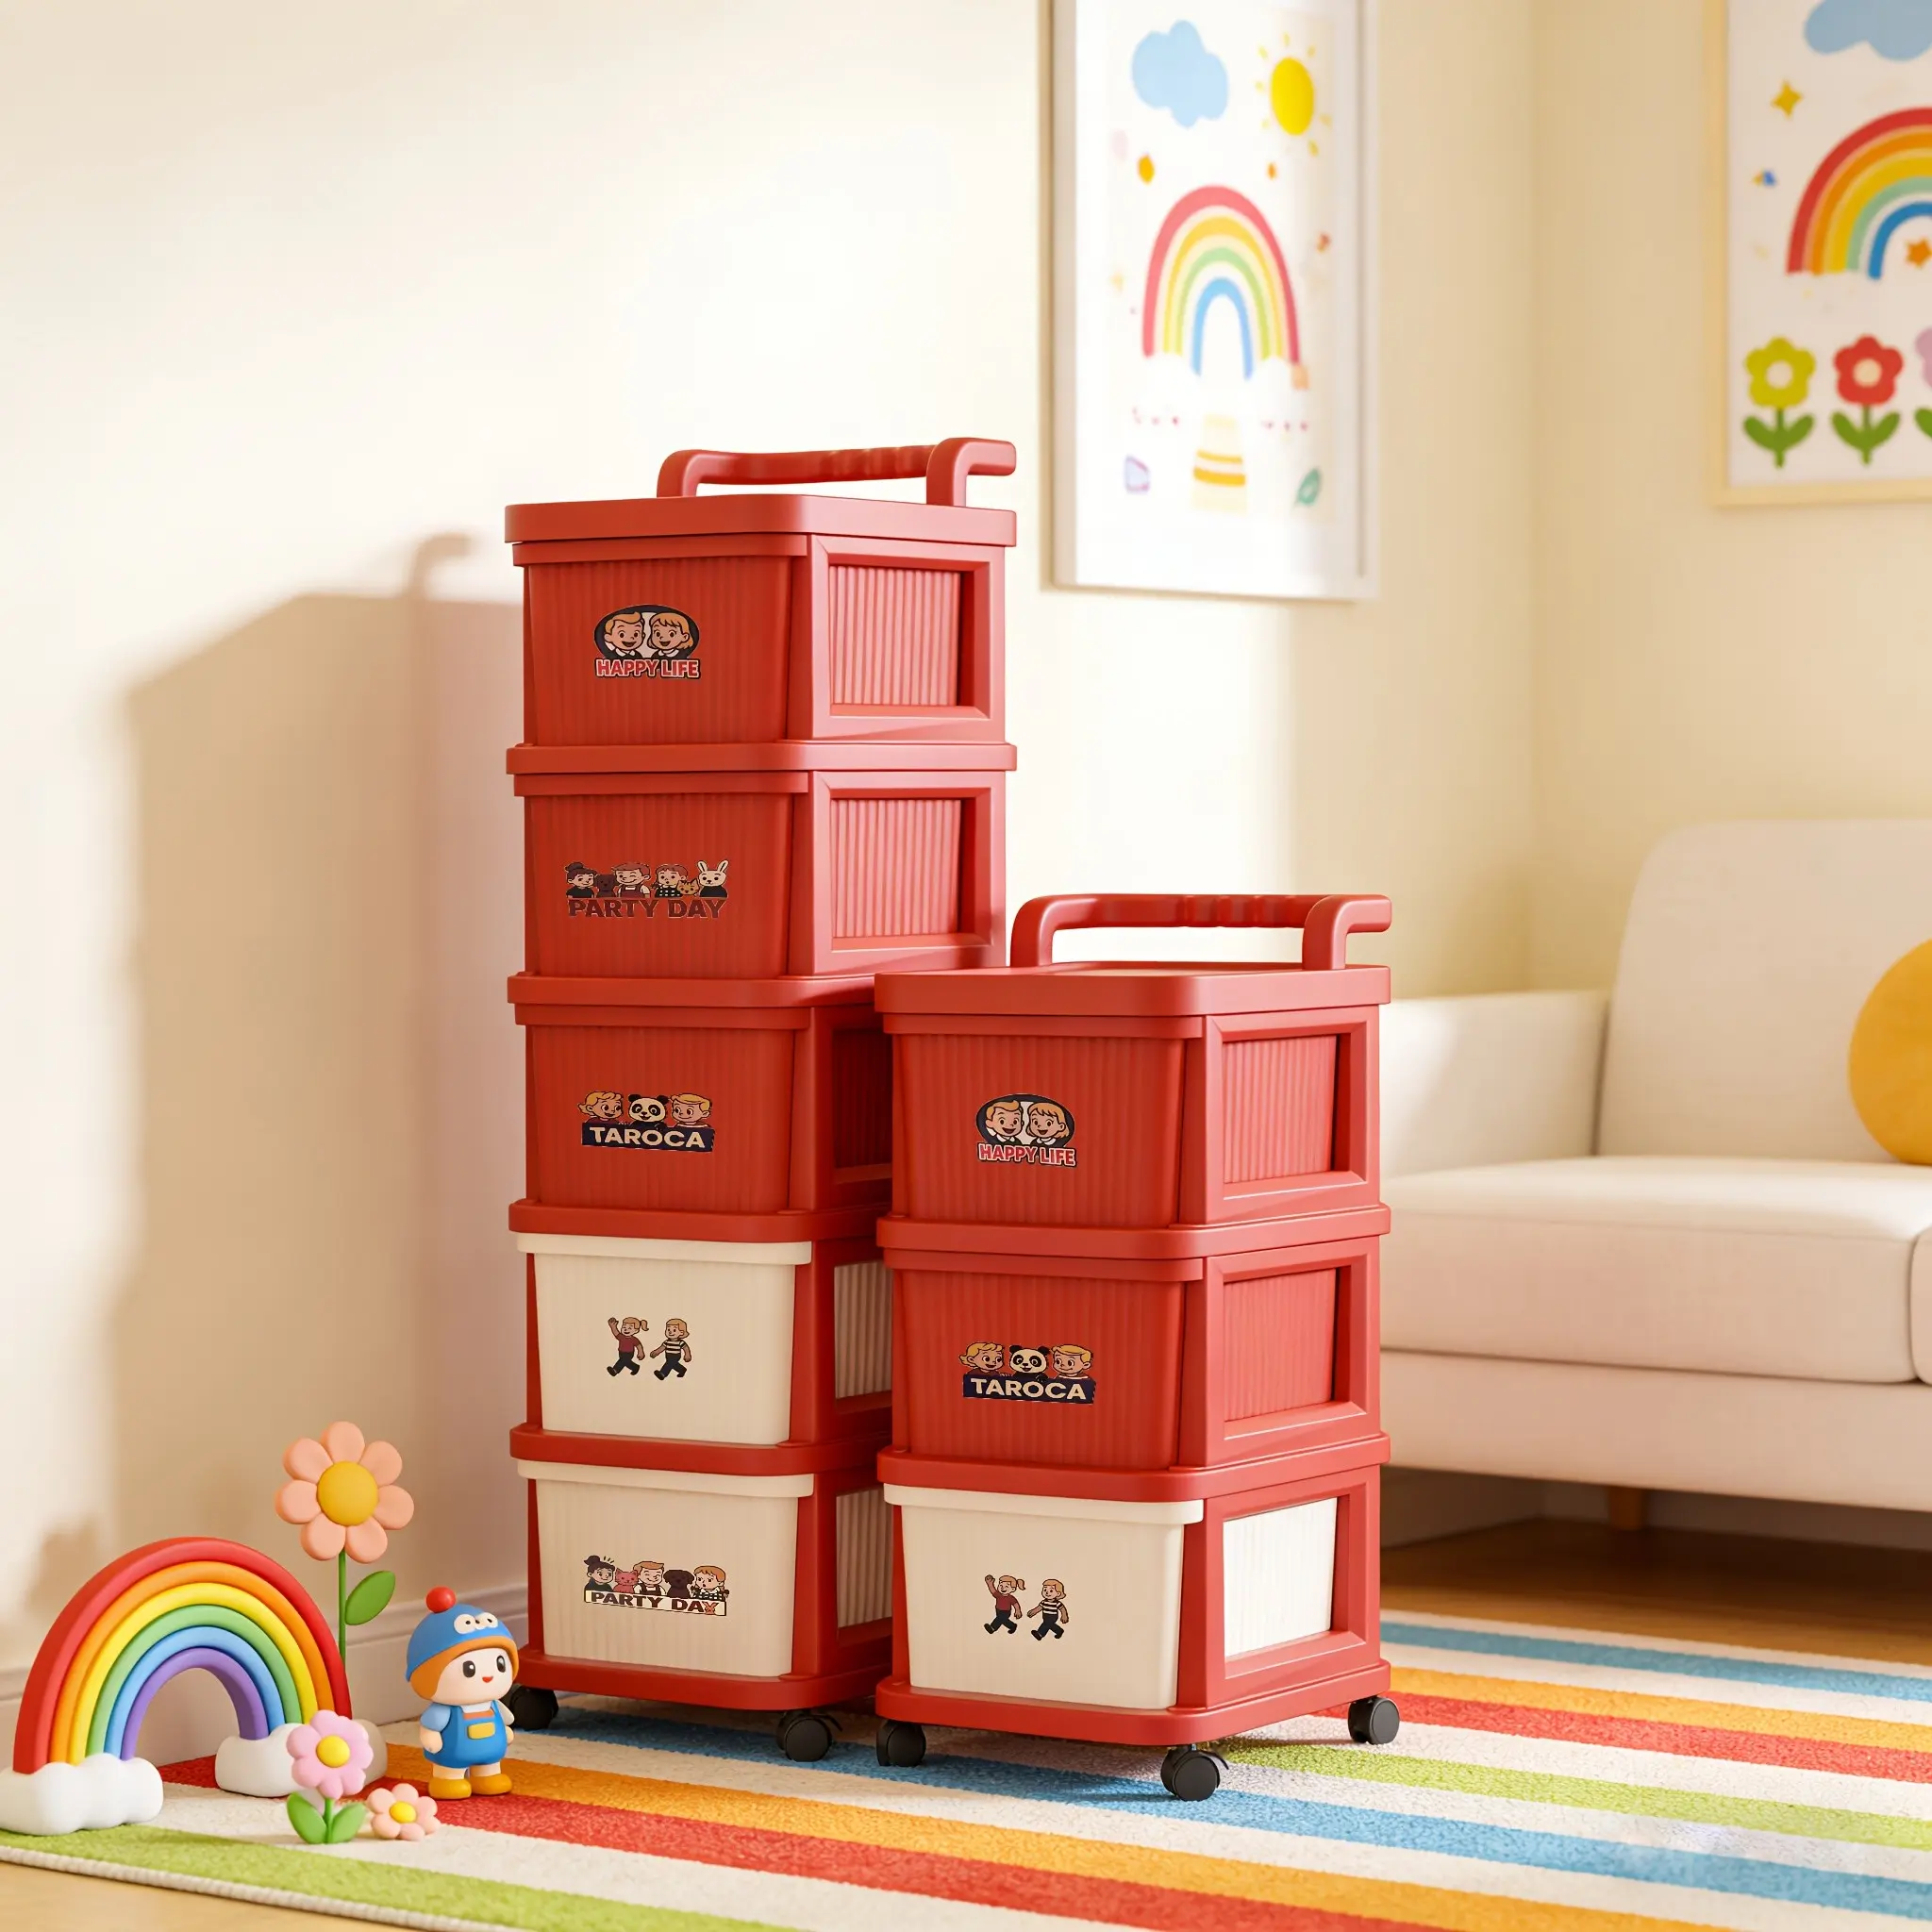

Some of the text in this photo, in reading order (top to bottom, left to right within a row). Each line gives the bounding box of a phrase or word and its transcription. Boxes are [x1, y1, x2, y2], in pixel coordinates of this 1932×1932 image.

[596, 659, 699, 678] HAPPY LIFE
[568, 899, 727, 918] PARTY DAY
[590, 1126, 705, 1148] TAROCA
[979, 1143, 1075, 1166] HAPPY LIFE
[971, 1377, 1086, 1399] TAROCA
[591, 1591, 717, 1615] PARTY DAY
